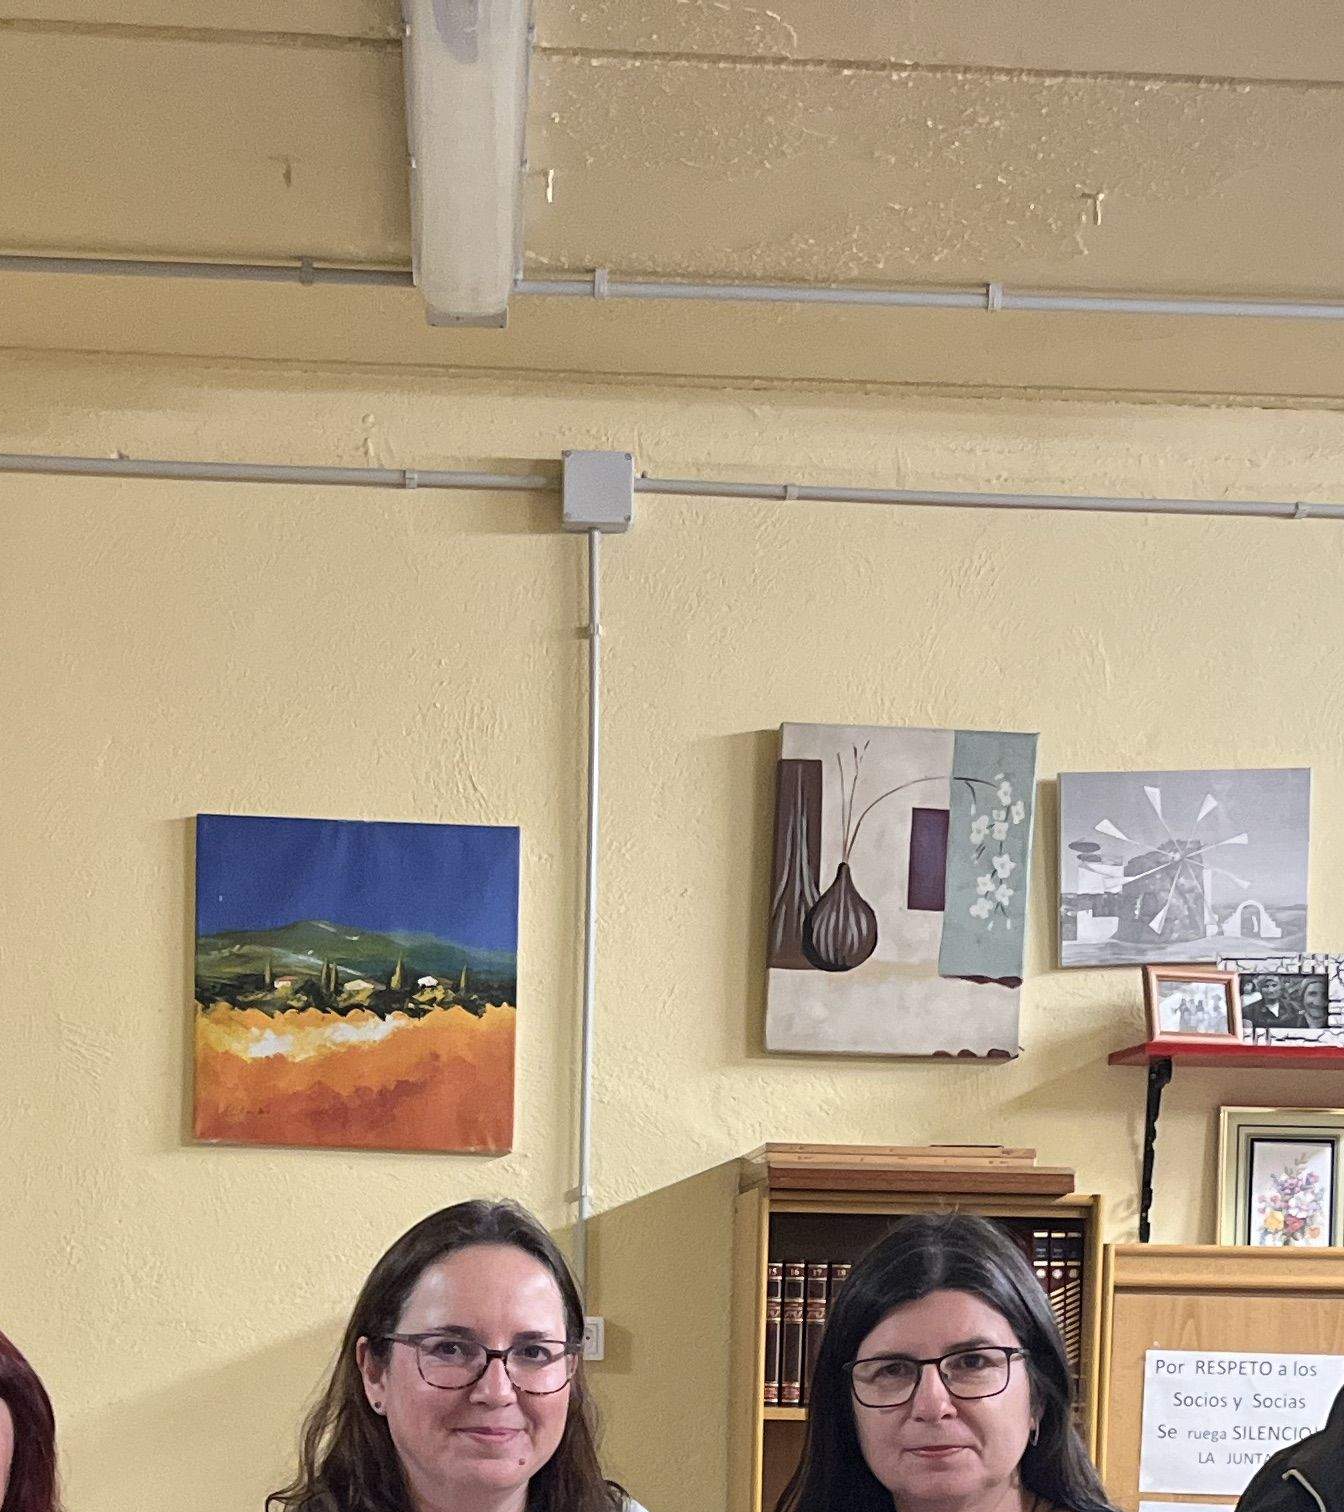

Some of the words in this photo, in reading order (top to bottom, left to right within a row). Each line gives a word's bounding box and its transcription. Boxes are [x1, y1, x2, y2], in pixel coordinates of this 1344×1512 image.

[1156, 1360, 1184, 1374] Por
[1196, 1360, 1272, 1376] RESPETO
[1278, 1364, 1287, 1376] a
[1294, 1361, 1317, 1376] los
[1173, 1392, 1227, 1407] Socios
[1232, 1397, 1242, 1411] y
[1253, 1393, 1306, 1409] Socias
[1157, 1424, 1177, 1439] Se
[1187, 1429, 1227, 1442] ruega
[1198, 1452, 1215, 1464] LA
[1227, 1453, 1271, 1464] JUNTA
